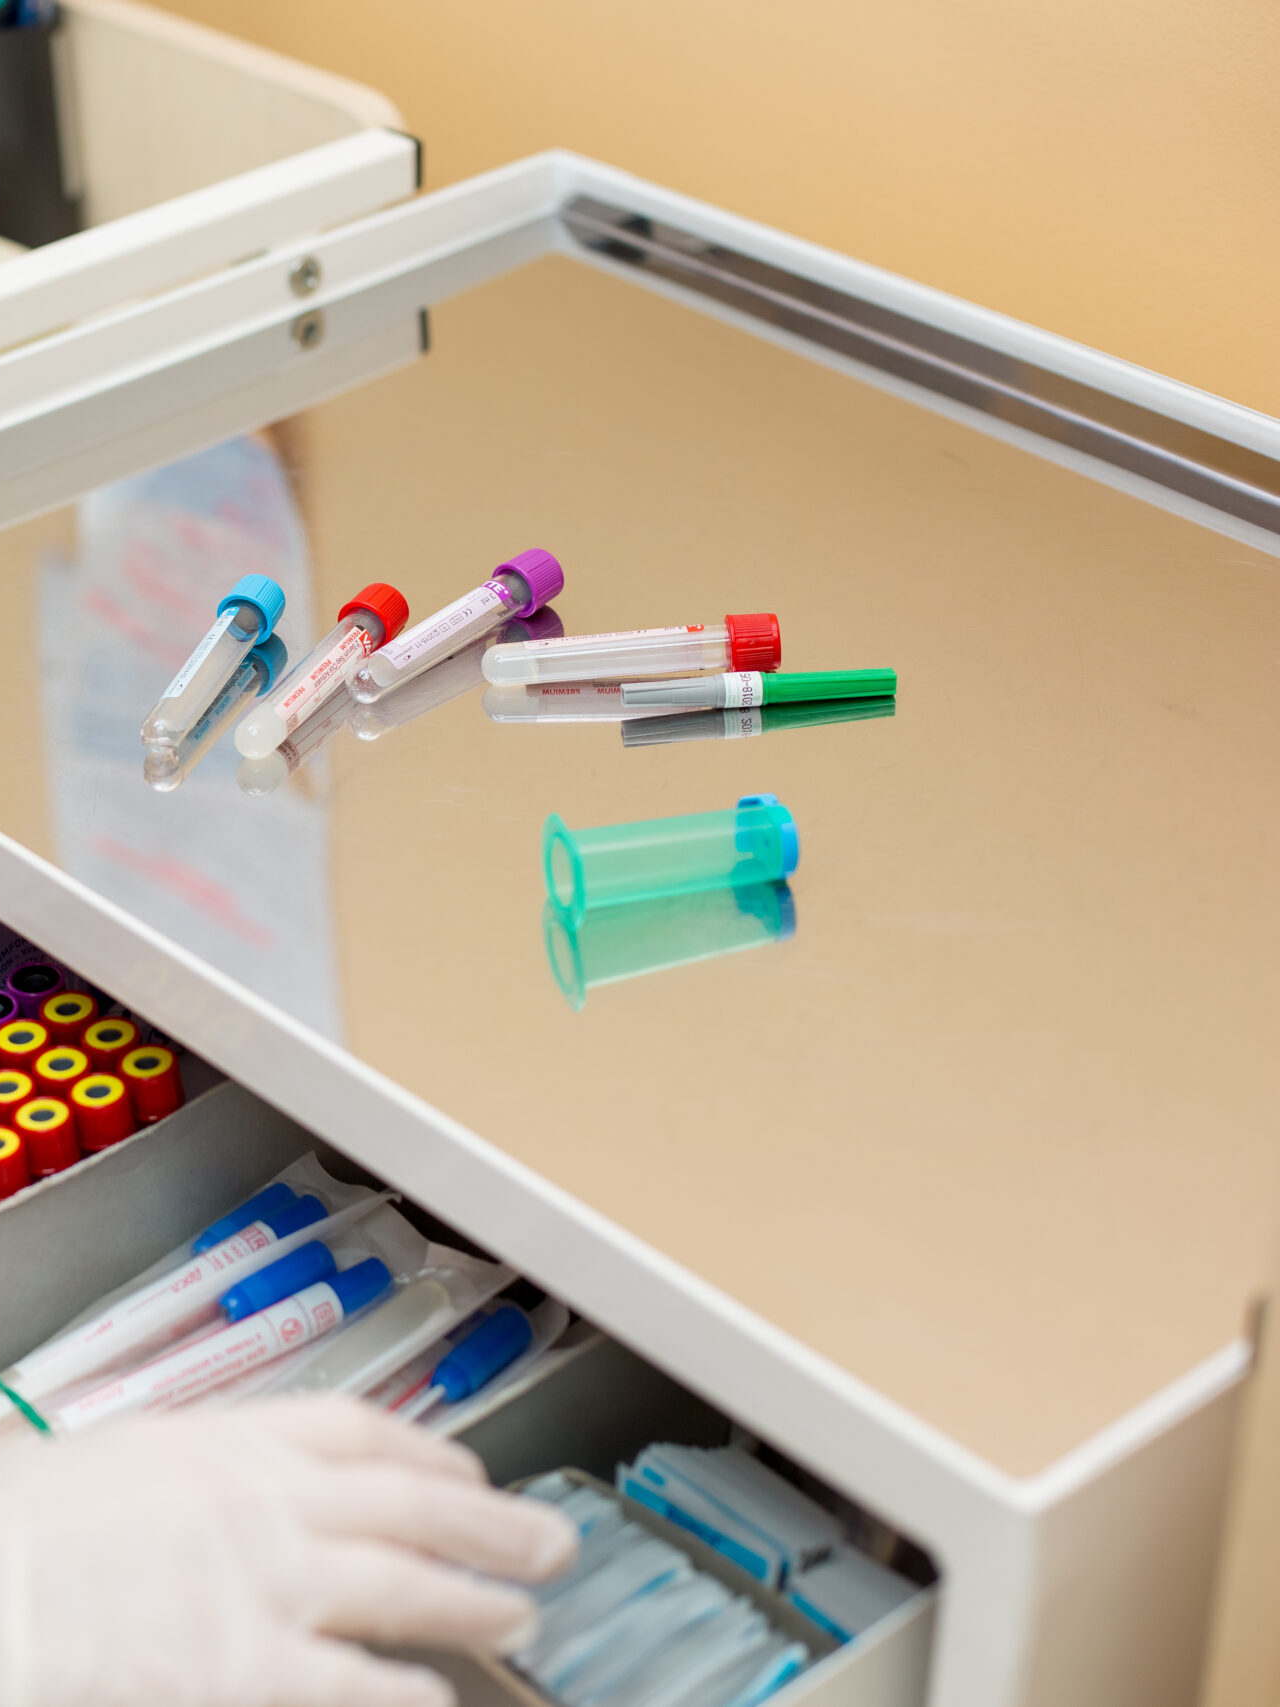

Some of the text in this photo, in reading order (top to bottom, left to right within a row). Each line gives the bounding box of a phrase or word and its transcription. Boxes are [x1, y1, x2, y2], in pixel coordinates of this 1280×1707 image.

[338, 627, 360, 651] PREMIUM
[309, 657, 332, 681] PREMIUM
[282, 684, 306, 709] PREMIUM
